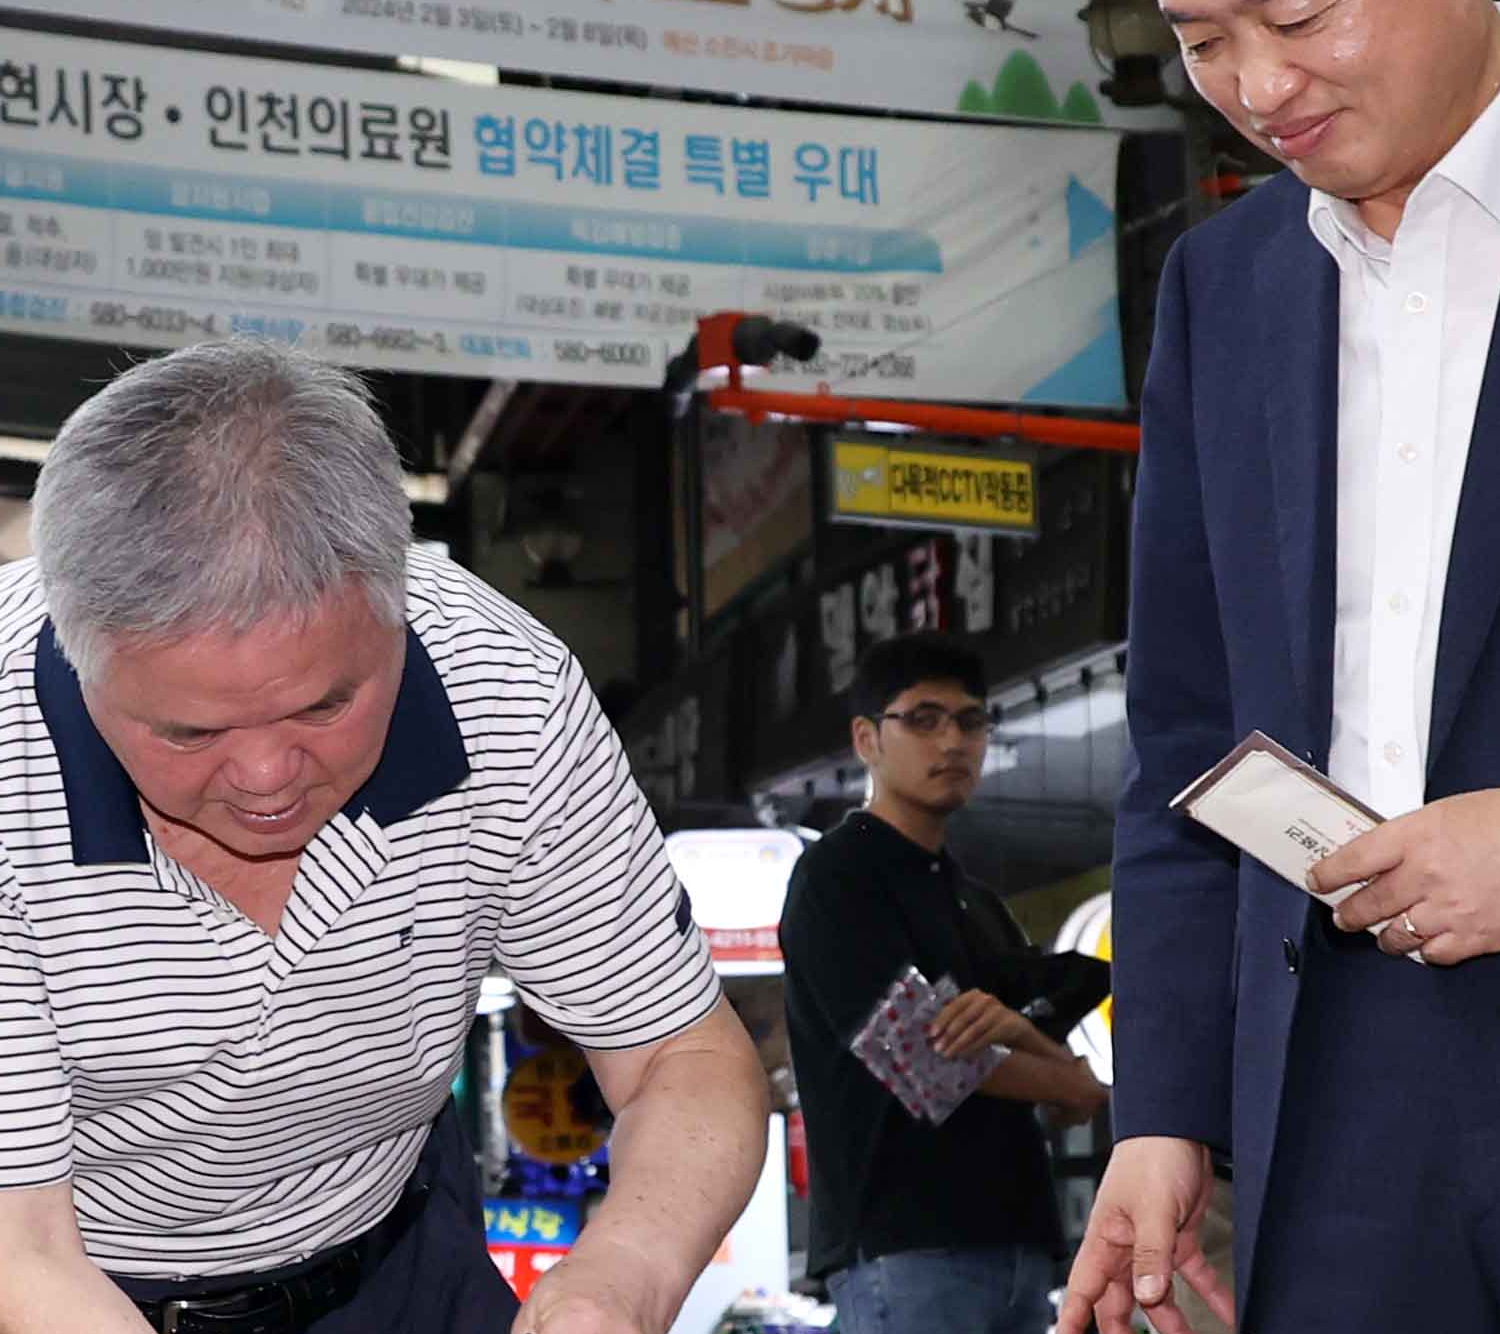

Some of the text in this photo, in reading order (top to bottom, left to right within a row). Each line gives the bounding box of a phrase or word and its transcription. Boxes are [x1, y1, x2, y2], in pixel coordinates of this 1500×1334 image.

[204, 84, 453, 170] 인천의료원
[472, 113, 662, 191] 협약체결
[683, 134, 772, 199] 특별
[792, 142, 881, 206] 우대
